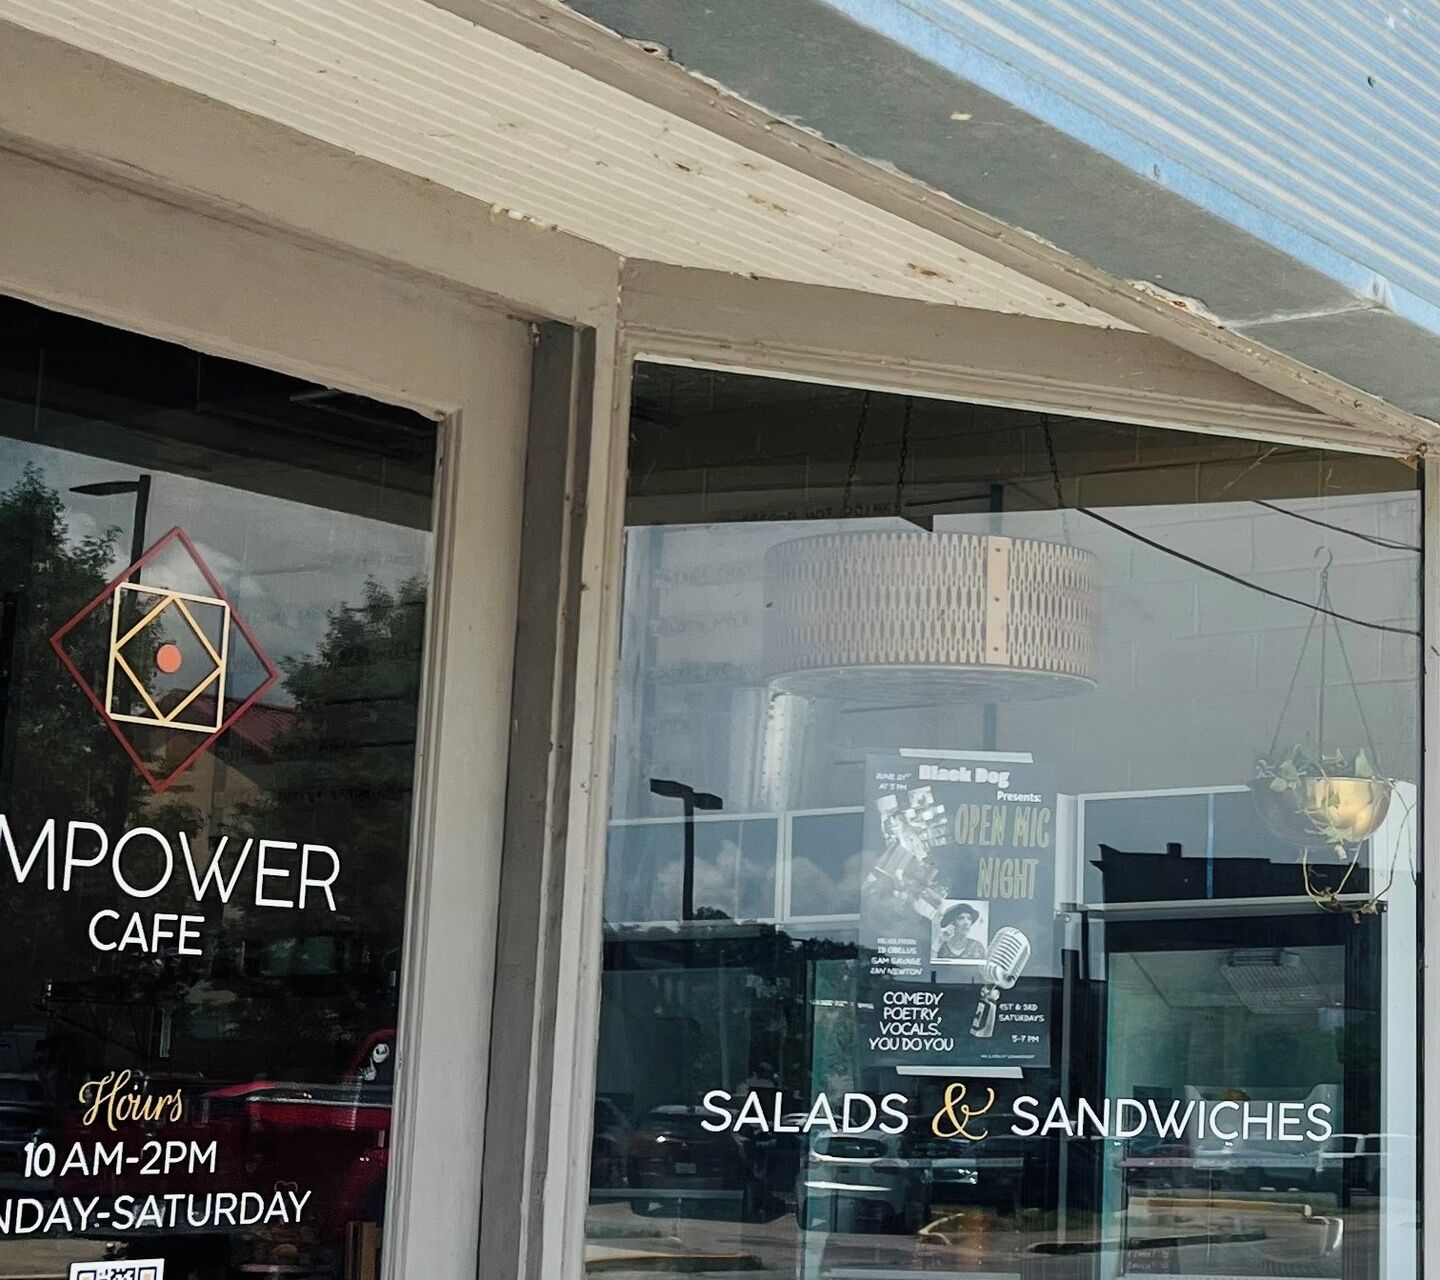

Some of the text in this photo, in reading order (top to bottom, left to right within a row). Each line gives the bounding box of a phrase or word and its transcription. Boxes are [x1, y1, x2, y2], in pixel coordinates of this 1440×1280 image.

[918, 764, 1010, 789] Black Dog
[996, 790, 1042, 804] Presents:
[954, 803, 1051, 849] OPEN MIC
[977, 856, 1039, 900] NIGHT
[88, 909, 206, 956] CAFE
[882, 990, 944, 1006] COMEDY
[883, 1006, 943, 1024] POETRY,
[998, 1013, 1046, 1023] SATURDAYS
[869, 1037, 954, 1052] YOU DO YOU
[78, 1068, 184, 1131] Hours
[700, 1082, 1333, 1143] SALADS & SANDWICHES
